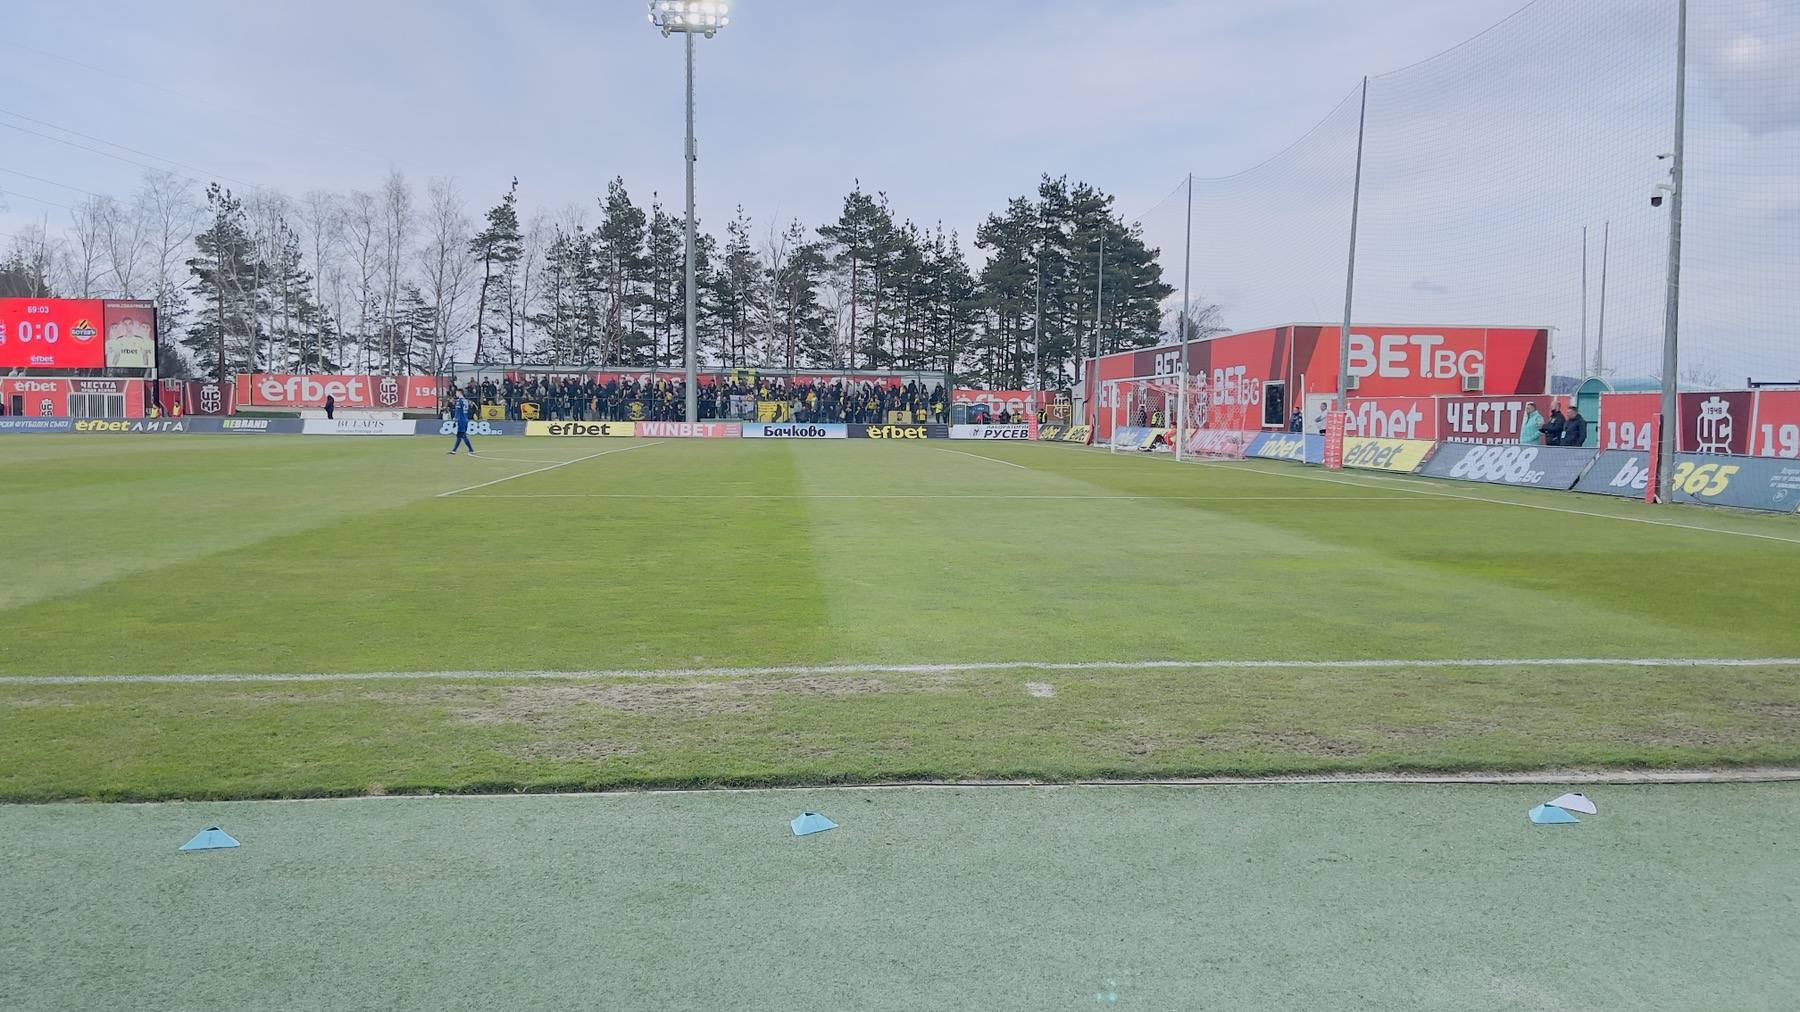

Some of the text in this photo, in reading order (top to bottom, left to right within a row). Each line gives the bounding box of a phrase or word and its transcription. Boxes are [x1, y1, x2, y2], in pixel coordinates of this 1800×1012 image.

[27, 305, 49, 314] 69:03
[18, 320, 59, 344] 0:0
[14, 381, 57, 391] efbet
[258, 376, 364, 401] efbet
[223, 420, 268, 428] REBRAND
[1447, 402, 1522, 433] ЧЕСТТ
[75, 420, 129, 431] efbet
[131, 421, 183, 431] ЛИГА
[549, 422, 610, 436] efbet
[641, 423, 717, 436] WINBET
[764, 425, 826, 437] Бачково
[866, 425, 928, 439] efbet
[984, 430, 1028, 438] РУСЕВ
[1607, 422, 1651, 450] 194
[1344, 440, 1403, 468] efbet
[1450, 446, 1544, 483] 8888.BG
[1609, 457, 1740, 496] be365
